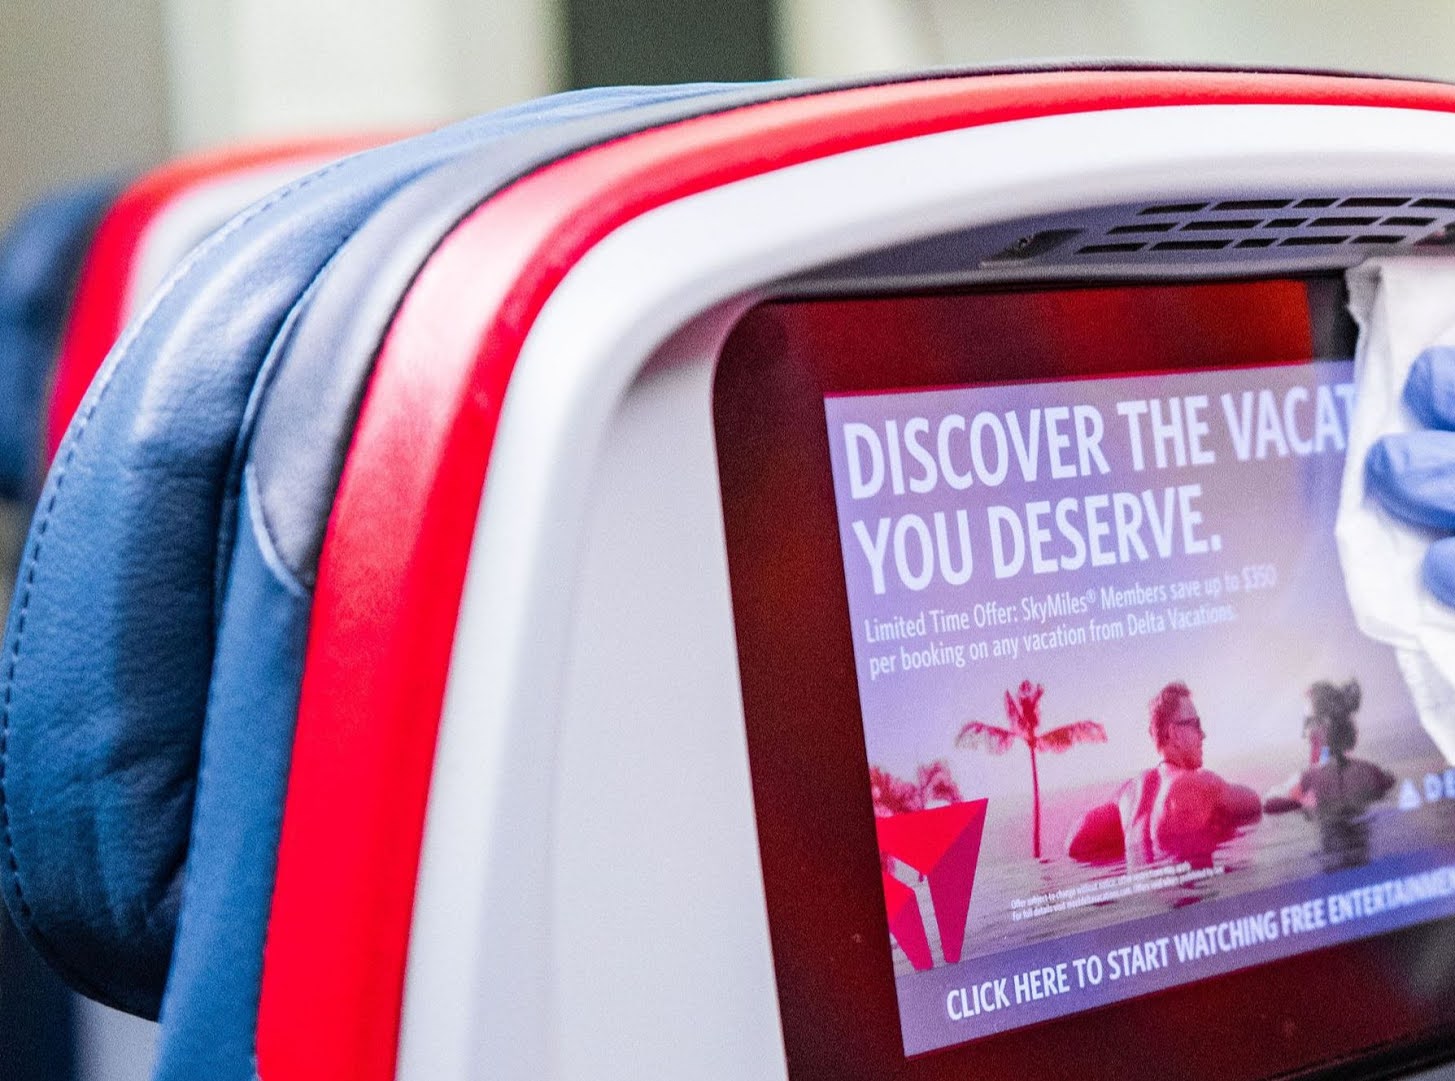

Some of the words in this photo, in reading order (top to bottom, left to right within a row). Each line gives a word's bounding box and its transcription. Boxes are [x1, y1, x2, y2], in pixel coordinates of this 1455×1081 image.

[842, 405, 1110, 500] DISCOVER
[1117, 394, 1216, 473] THE
[852, 508, 974, 595] YOU
[987, 484, 1222, 580] DESERVE.
[864, 611, 926, 643] Limited
[929, 609, 970, 633] Time
[973, 600, 1018, 628] Offer:
[1100, 581, 1167, 610] Members
[1170, 579, 1200, 597] save
[1204, 576, 1222, 598] up
[1224, 571, 1239, 591] to
[869, 655, 897, 681] per
[900, 641, 967, 669] booking
[969, 641, 989, 660] on
[992, 637, 1019, 660] any
[1023, 622, 1086, 653] vacation
[1089, 617, 1124, 642] from
[1127, 610, 1165, 638] Delta
[946, 976, 1012, 1021] CLICK
[1013, 962, 1070, 1005] HERE
[1073, 954, 1103, 988] TO
[1107, 937, 1169, 980] START
[1173, 911, 1278, 963] WATCHING
[1280, 898, 1328, 937] FREE
